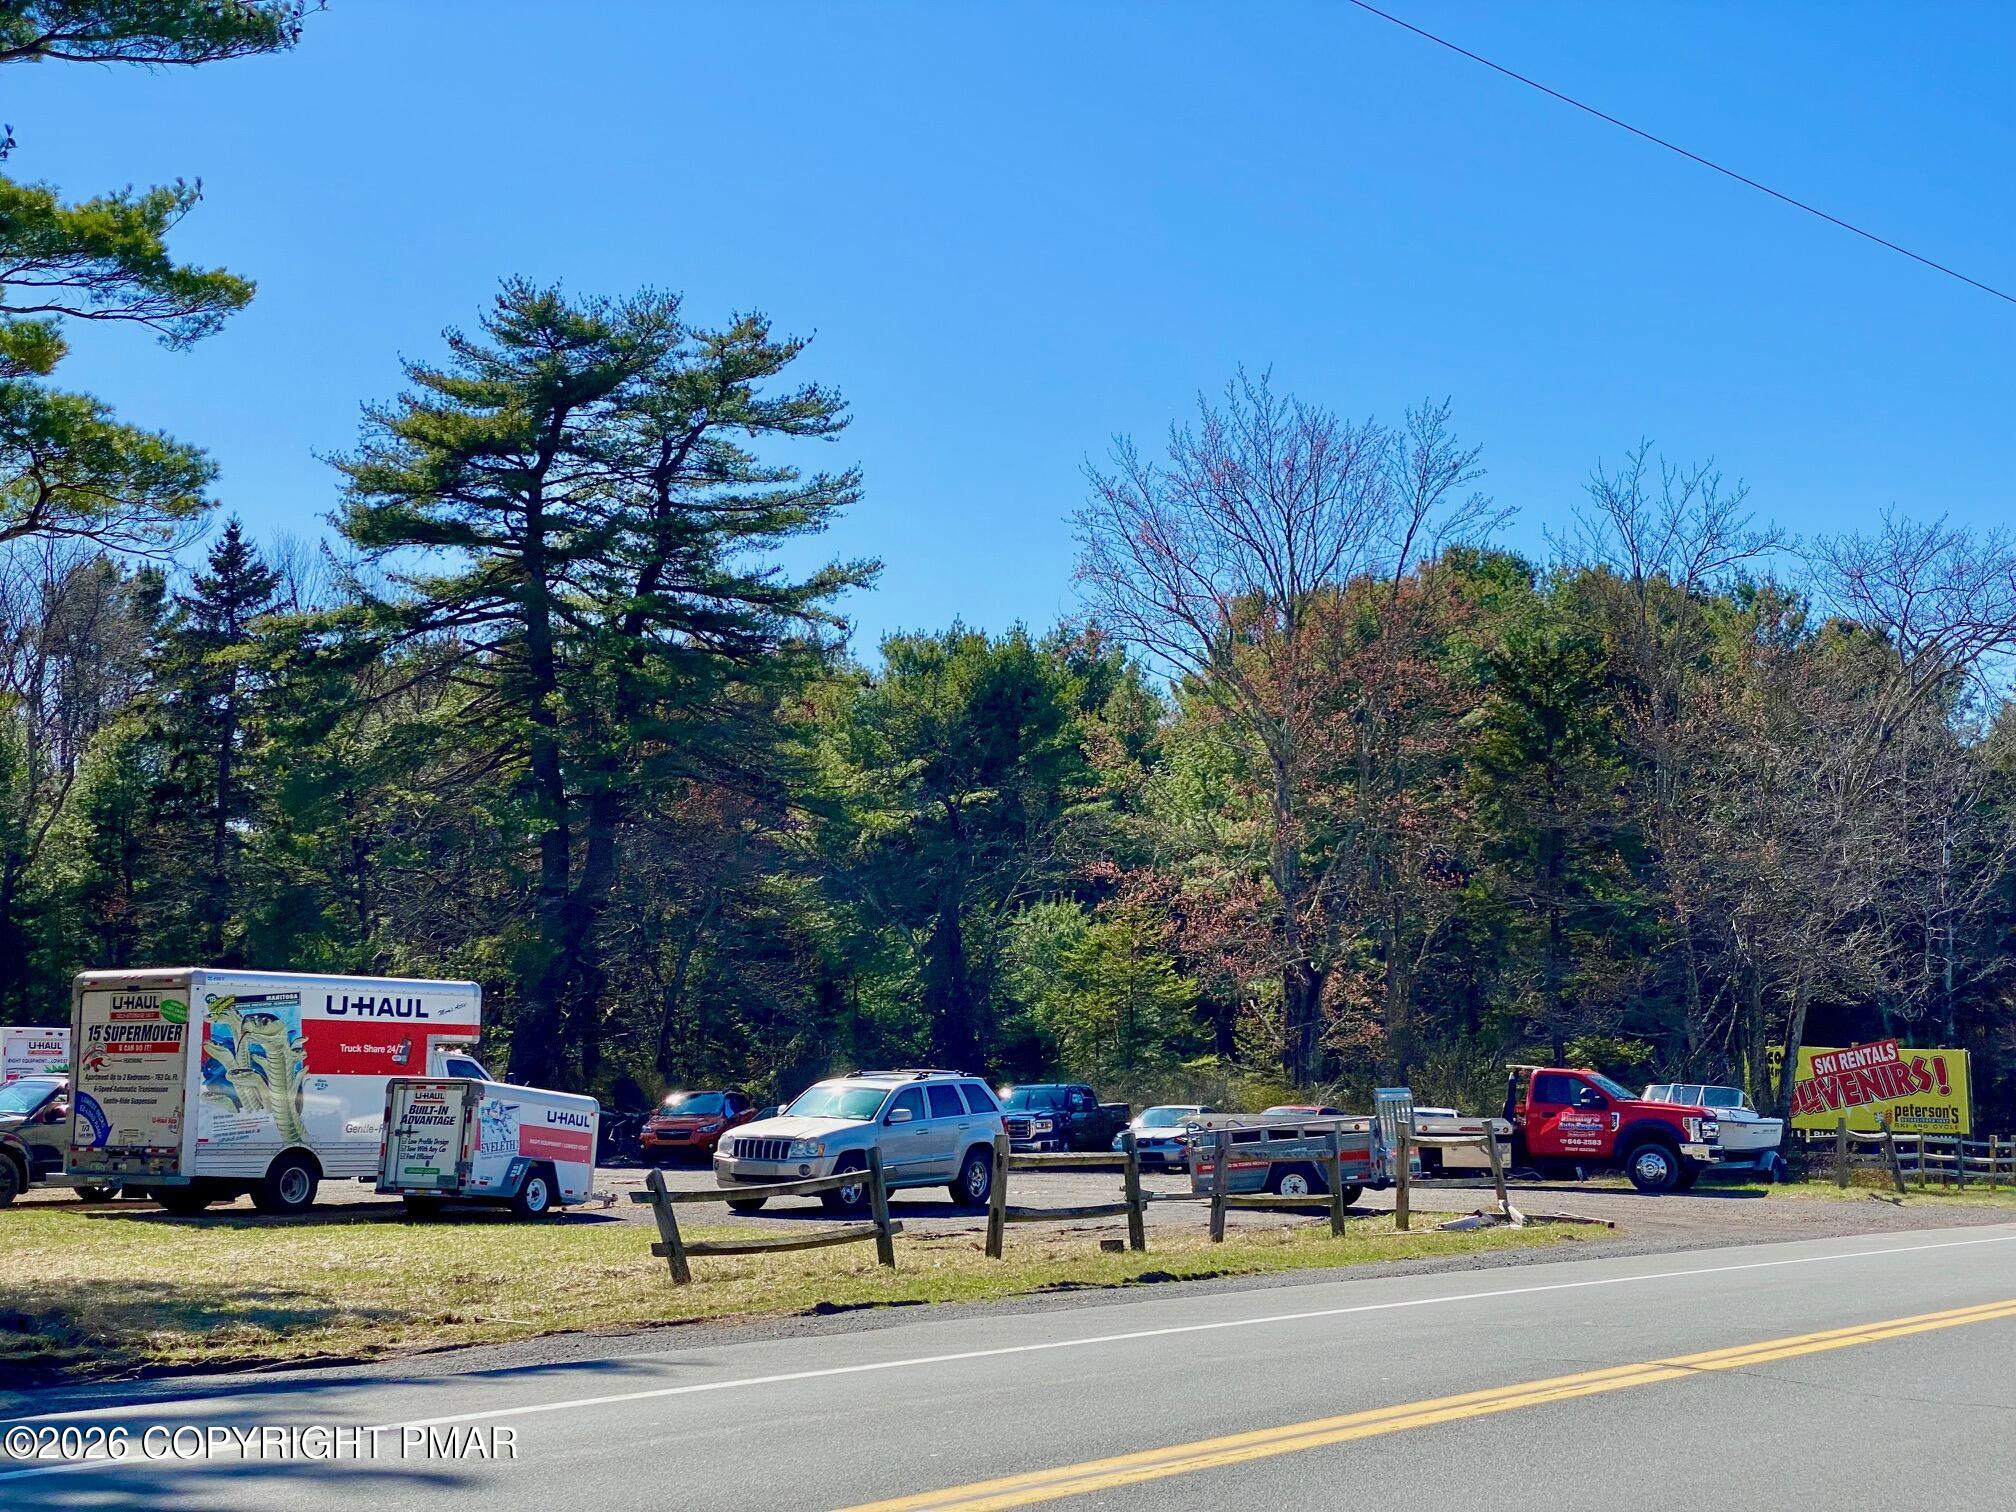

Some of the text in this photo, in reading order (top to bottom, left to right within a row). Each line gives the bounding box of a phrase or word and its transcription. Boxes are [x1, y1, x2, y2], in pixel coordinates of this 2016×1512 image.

[112, 995, 160, 1009] U-HAUL
[265, 993, 298, 1001] MANITOBA
[326, 995, 429, 1018] U-HAUL
[103, 1024, 183, 1042] SUPERMOVER
[135, 1044, 143, 1052] DO
[144, 1044, 152, 1052] IT!
[340, 1043, 405, 1055] Truck Share 24/7
[1814, 1042, 1897, 1075] SKI RENTALS
[409, 1105, 449, 1115] BUILT-IN
[1894, 1104, 1959, 1124] peterson's
[401, 1114, 456, 1126] ADVANTAGE
[547, 1110, 590, 1128] U-HAUL
